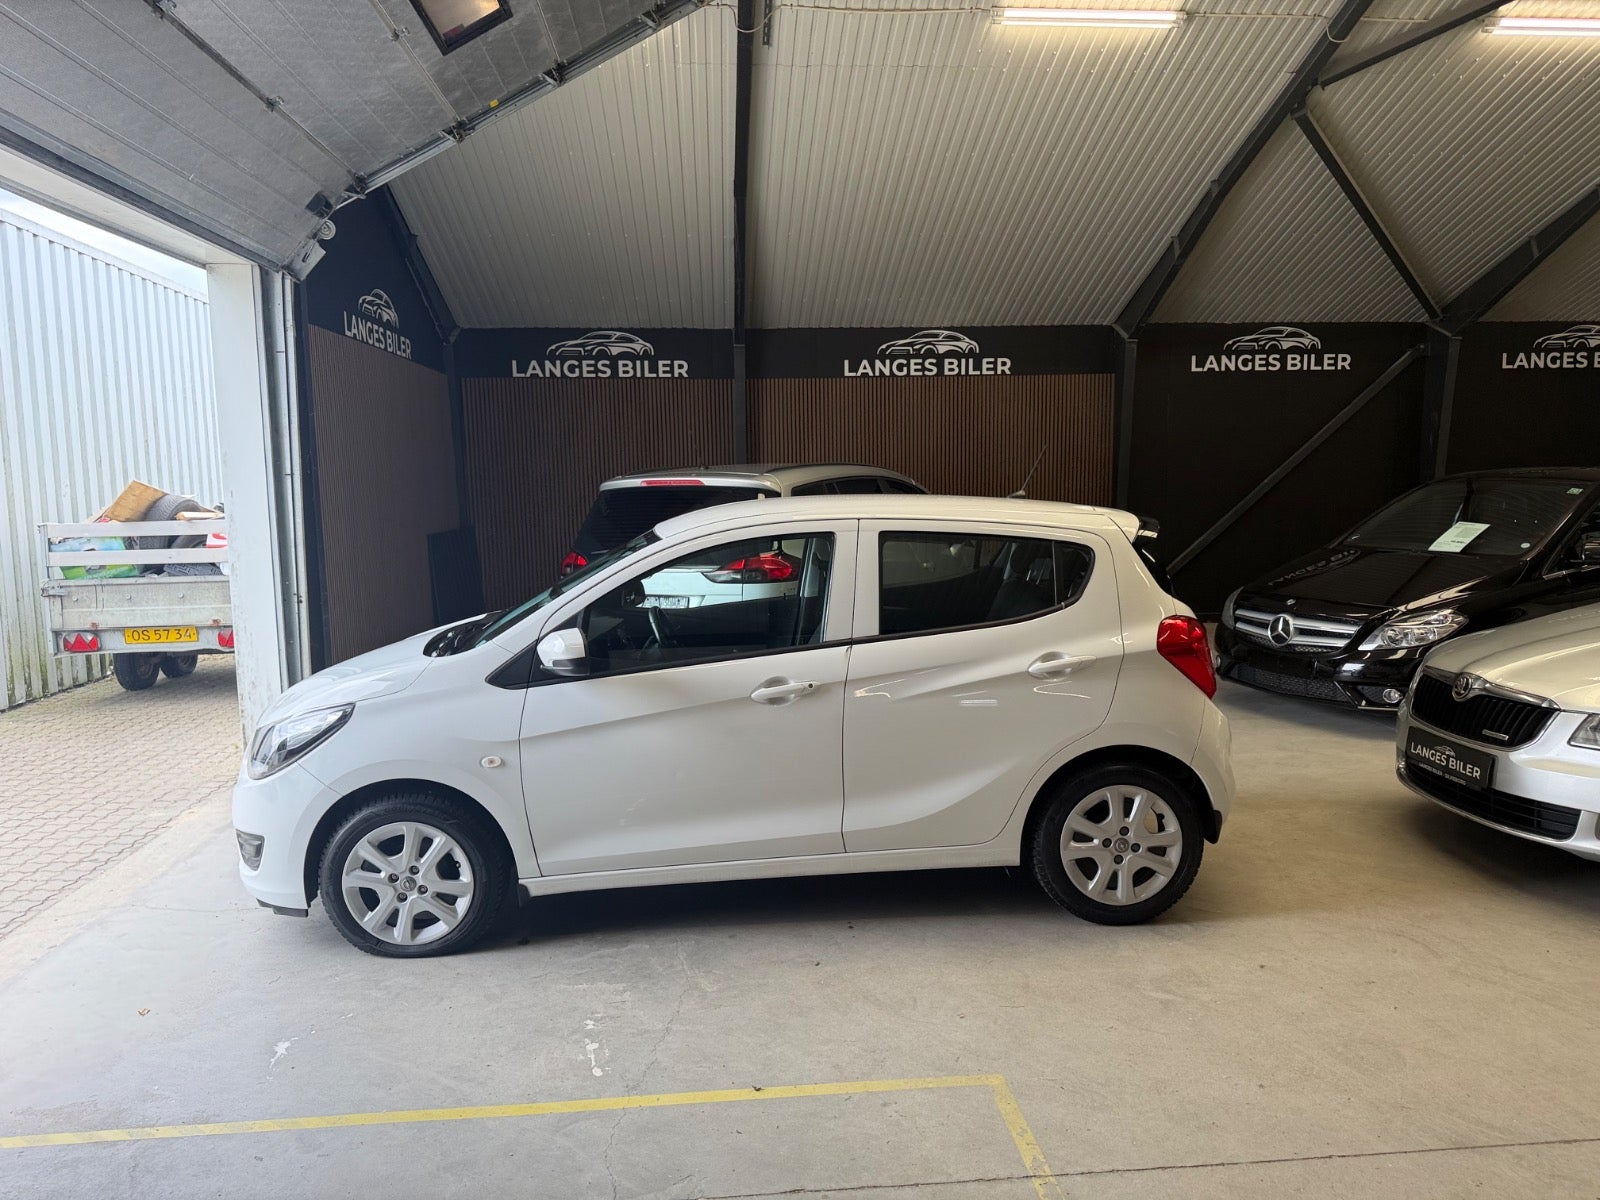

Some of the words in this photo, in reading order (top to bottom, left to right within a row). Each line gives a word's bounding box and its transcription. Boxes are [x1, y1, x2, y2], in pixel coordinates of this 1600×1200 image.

[343, 310, 386, 350] LANGES
[385, 329, 412, 361] BILER
[511, 359, 611, 378] LANGES
[617, 359, 689, 378] BILER
[843, 358, 938, 377] LANGES
[943, 357, 1012, 376] BILER
[1191, 354, 1281, 372] LANGES
[1286, 353, 1352, 371] BILER
[1501, 351, 1589, 369] LANGES
[1410, 741, 1447, 766] LANGES
[1448, 757, 1481, 780] BILER
